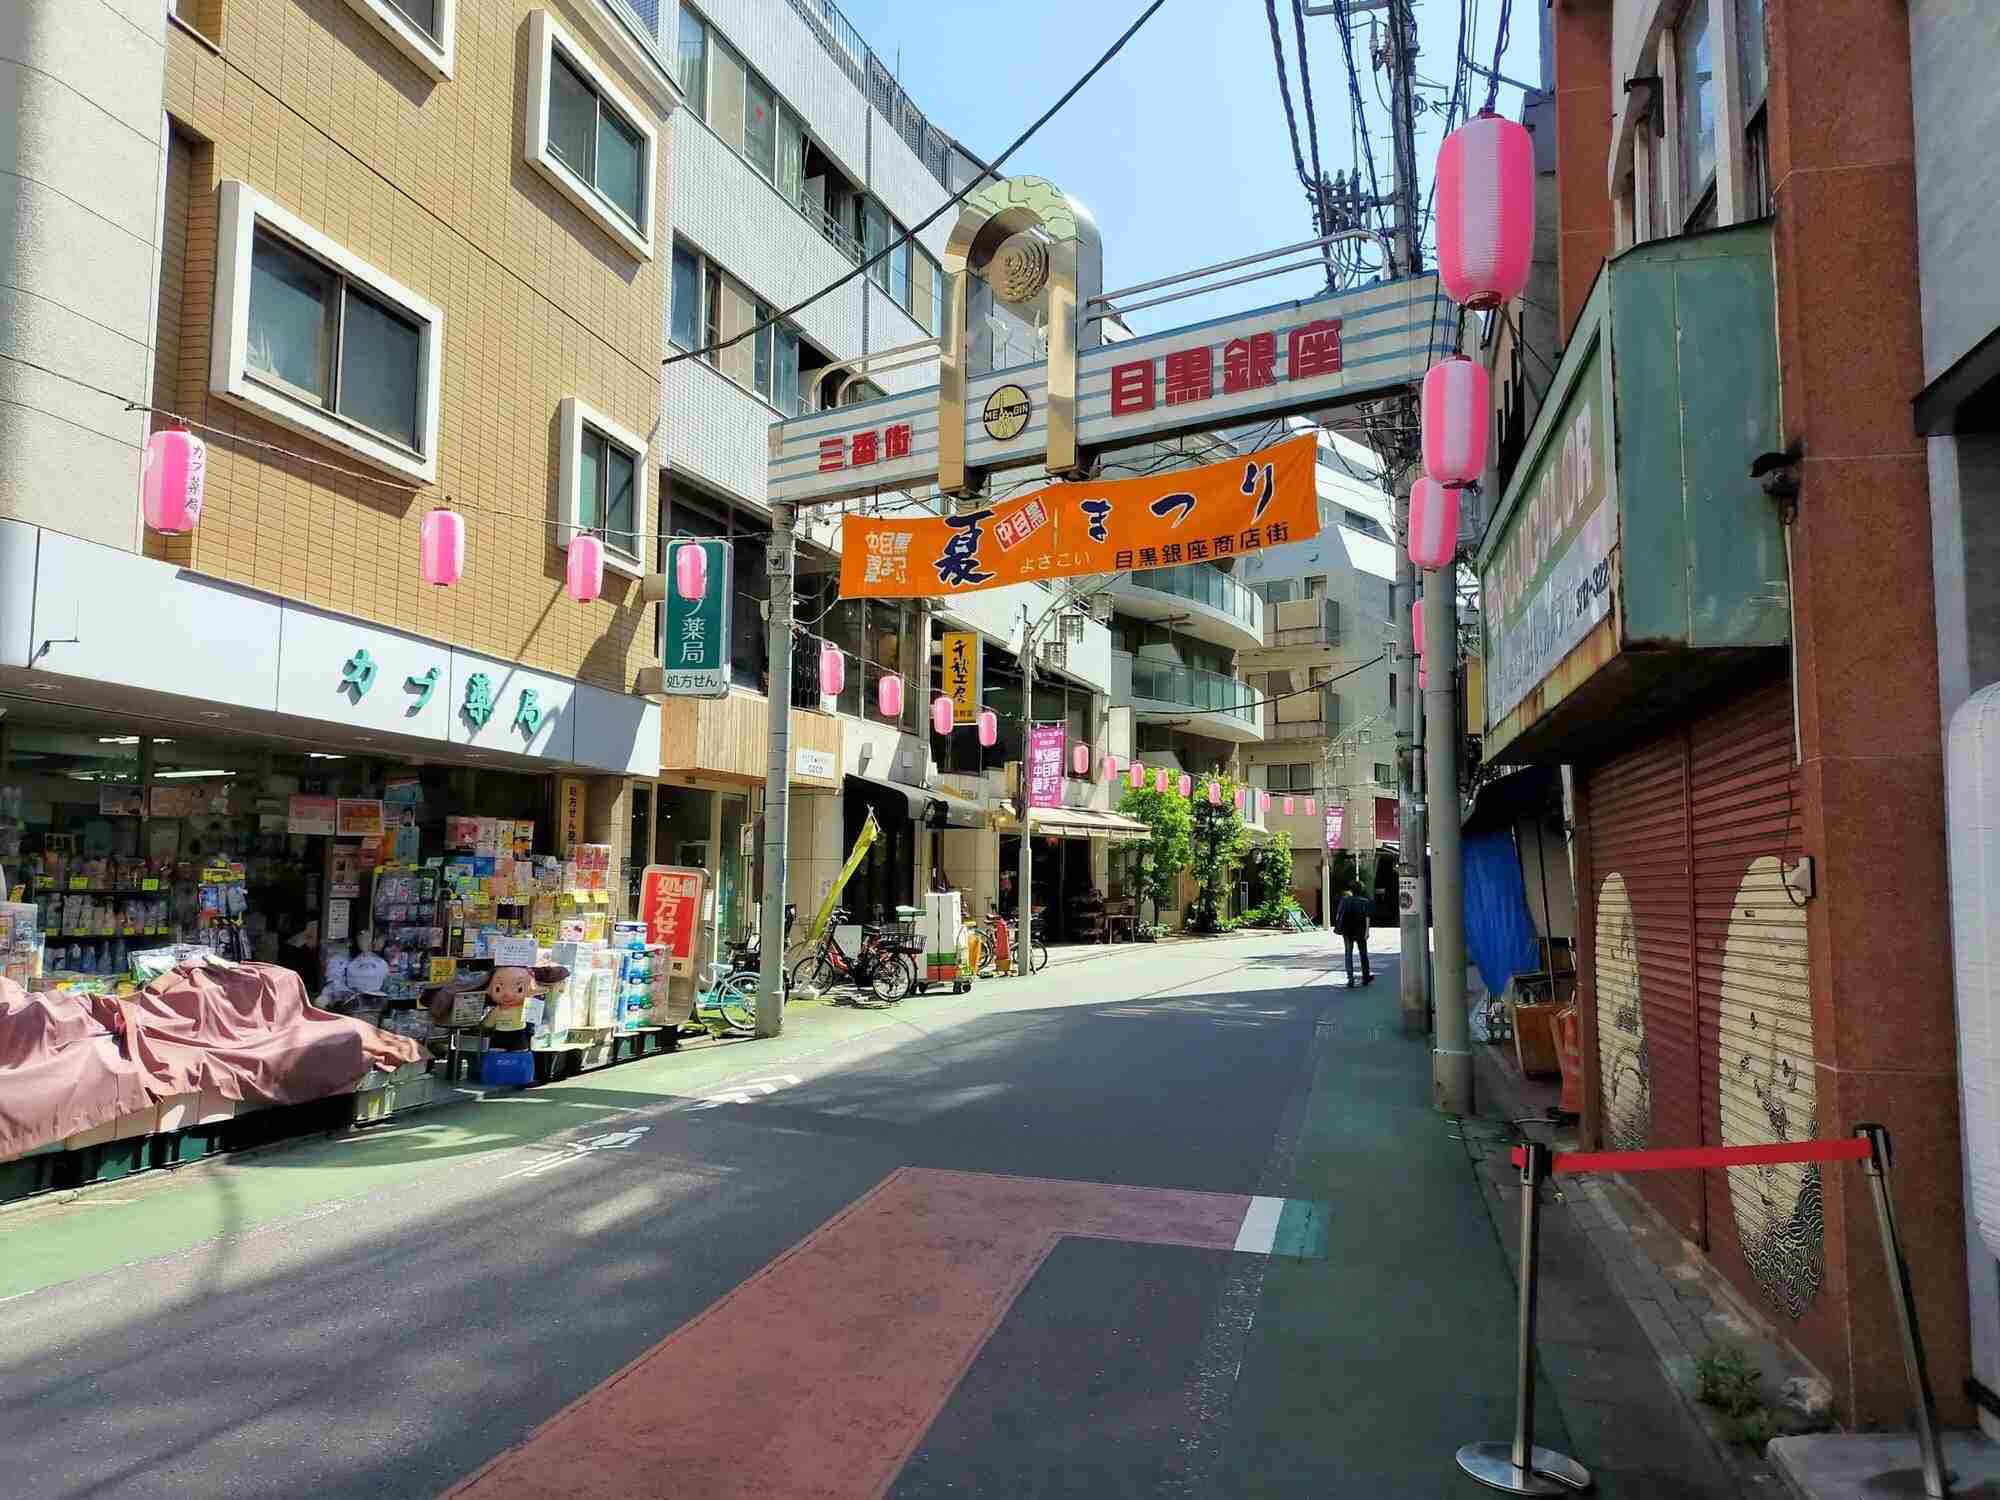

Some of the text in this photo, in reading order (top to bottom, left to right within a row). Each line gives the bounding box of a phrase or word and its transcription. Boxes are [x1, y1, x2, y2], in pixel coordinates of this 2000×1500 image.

[1112, 319, 1342, 417] 目黒銀座
[817, 423, 912, 472] 三番街
[864, 531, 912, 556] 中目黒
[996, 500, 1047, 546] 中目黒
[1115, 522, 1289, 569] 目黒銀座商店街
[1020, 552, 1091, 573] よさこい
[341, 648, 547, 735] カブ薬局
[667, 674, 718, 689] 処方せん
